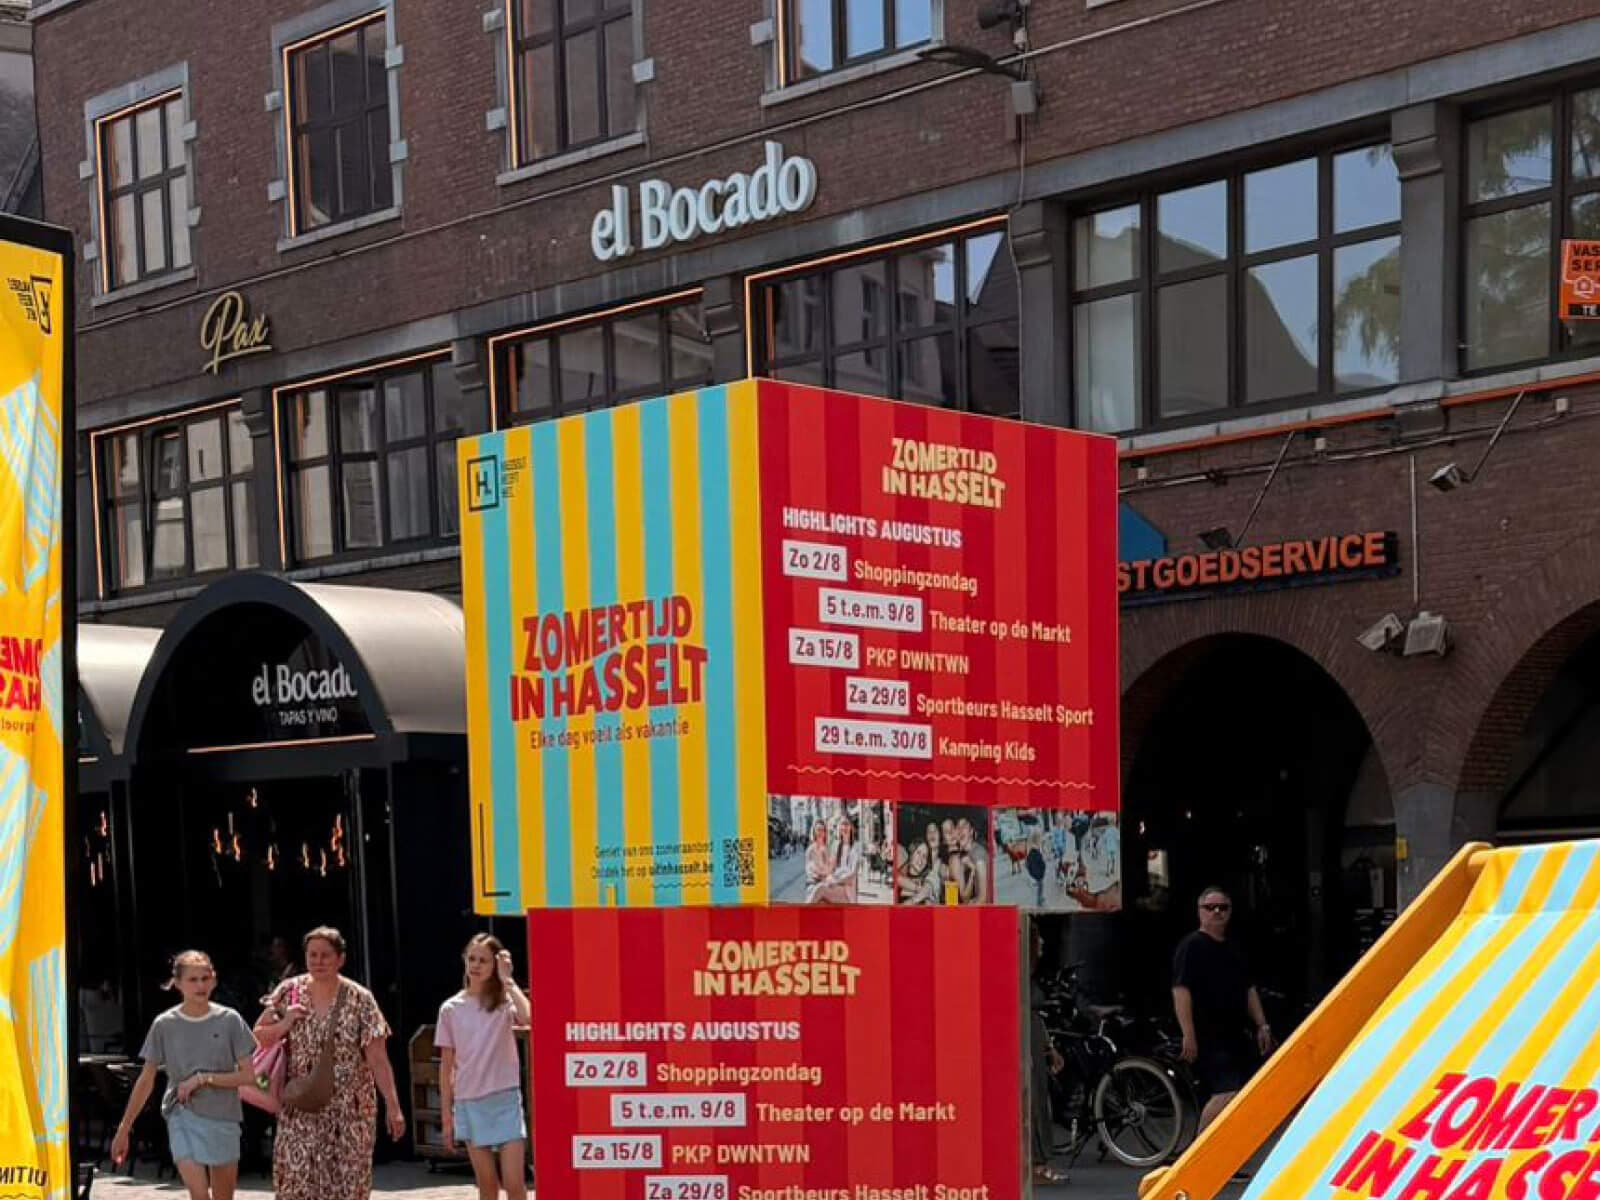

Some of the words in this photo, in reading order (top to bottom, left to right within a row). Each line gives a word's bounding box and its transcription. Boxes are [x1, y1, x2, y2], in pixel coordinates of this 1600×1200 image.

[591, 184, 630, 260] el
[640, 141, 817, 249] Bocado
[201, 291, 272, 376] Pax
[892, 437, 998, 475] ZOMERTIJD
[882, 465, 907, 496] IN
[910, 470, 1006, 509] HASSELT
[783, 507, 877, 538] HIGHLIGHTS
[880, 521, 962, 548] AUGUSTUS
[789, 547, 809, 569] Zo
[813, 550, 841, 573] 2/8
[854, 559, 978, 597] Shoppingzondag
[826, 596, 837, 614] 5
[840, 598, 884, 621] t.e.m.
[888, 602, 915, 623] 9/8
[522, 595, 693, 672] ZOMERTIJD
[930, 610, 986, 636] Theater
[990, 619, 1006, 641] op
[1010, 619, 1028, 639] de
[1032, 621, 1071, 644] Markt
[795, 636, 814, 657] Za
[819, 637, 853, 660] 15/8
[866, 647, 896, 667] PKP
[901, 650, 970, 675] DWNTWN
[252, 663, 271, 705] el
[510, 674, 546, 722] IN
[552, 642, 708, 718] HASSELT
[849, 684, 867, 703] Za
[872, 685, 907, 707] 29/8
[916, 693, 998, 719] Sportbeurs
[1001, 699, 1052, 722] Hasselt
[1056, 705, 1094, 728] Sport
[530, 730, 555, 749] Elke
[558, 727, 580, 749] dag
[616, 722, 633, 741] als
[636, 716, 689, 739] vakantie
[821, 725, 840, 744] 29
[843, 727, 888, 749] t.e.m.
[891, 729, 927, 751] 30/8
[938, 737, 1001, 764] Kamping
[1005, 741, 1036, 762] Kids
[706, 940, 849, 973] ZOMERTIJD
[693, 970, 725, 996] IN
[731, 963, 862, 996] HASSELT
[565, 1021, 686, 1041] HIGHLIGHTS
[691, 1021, 801, 1041] AUGUSTUS
[573, 1060, 598, 1079] Zo
[603, 1060, 639, 1079] 2/8
[656, 1063, 823, 1086] Shoppingzondag
[620, 1101, 634, 1119] 5
[638, 1102, 695, 1120] t.e.m.
[701, 1100, 736, 1119] 9/8
[755, 1103, 834, 1123] Theater
[839, 1107, 863, 1127] op
[869, 1103, 893, 1122] de
[899, 1102, 955, 1122] Markt
[1398, 1073, 1600, 1150] ZOMER
[581, 1142, 605, 1161] Za
[610, 1141, 654, 1161] 15/8
[672, 1145, 711, 1164] PKP
[717, 1144, 810, 1164] DWNTWN
[1330, 1130, 1416, 1198] IN
[678, 1182, 725, 1200] 29/8
